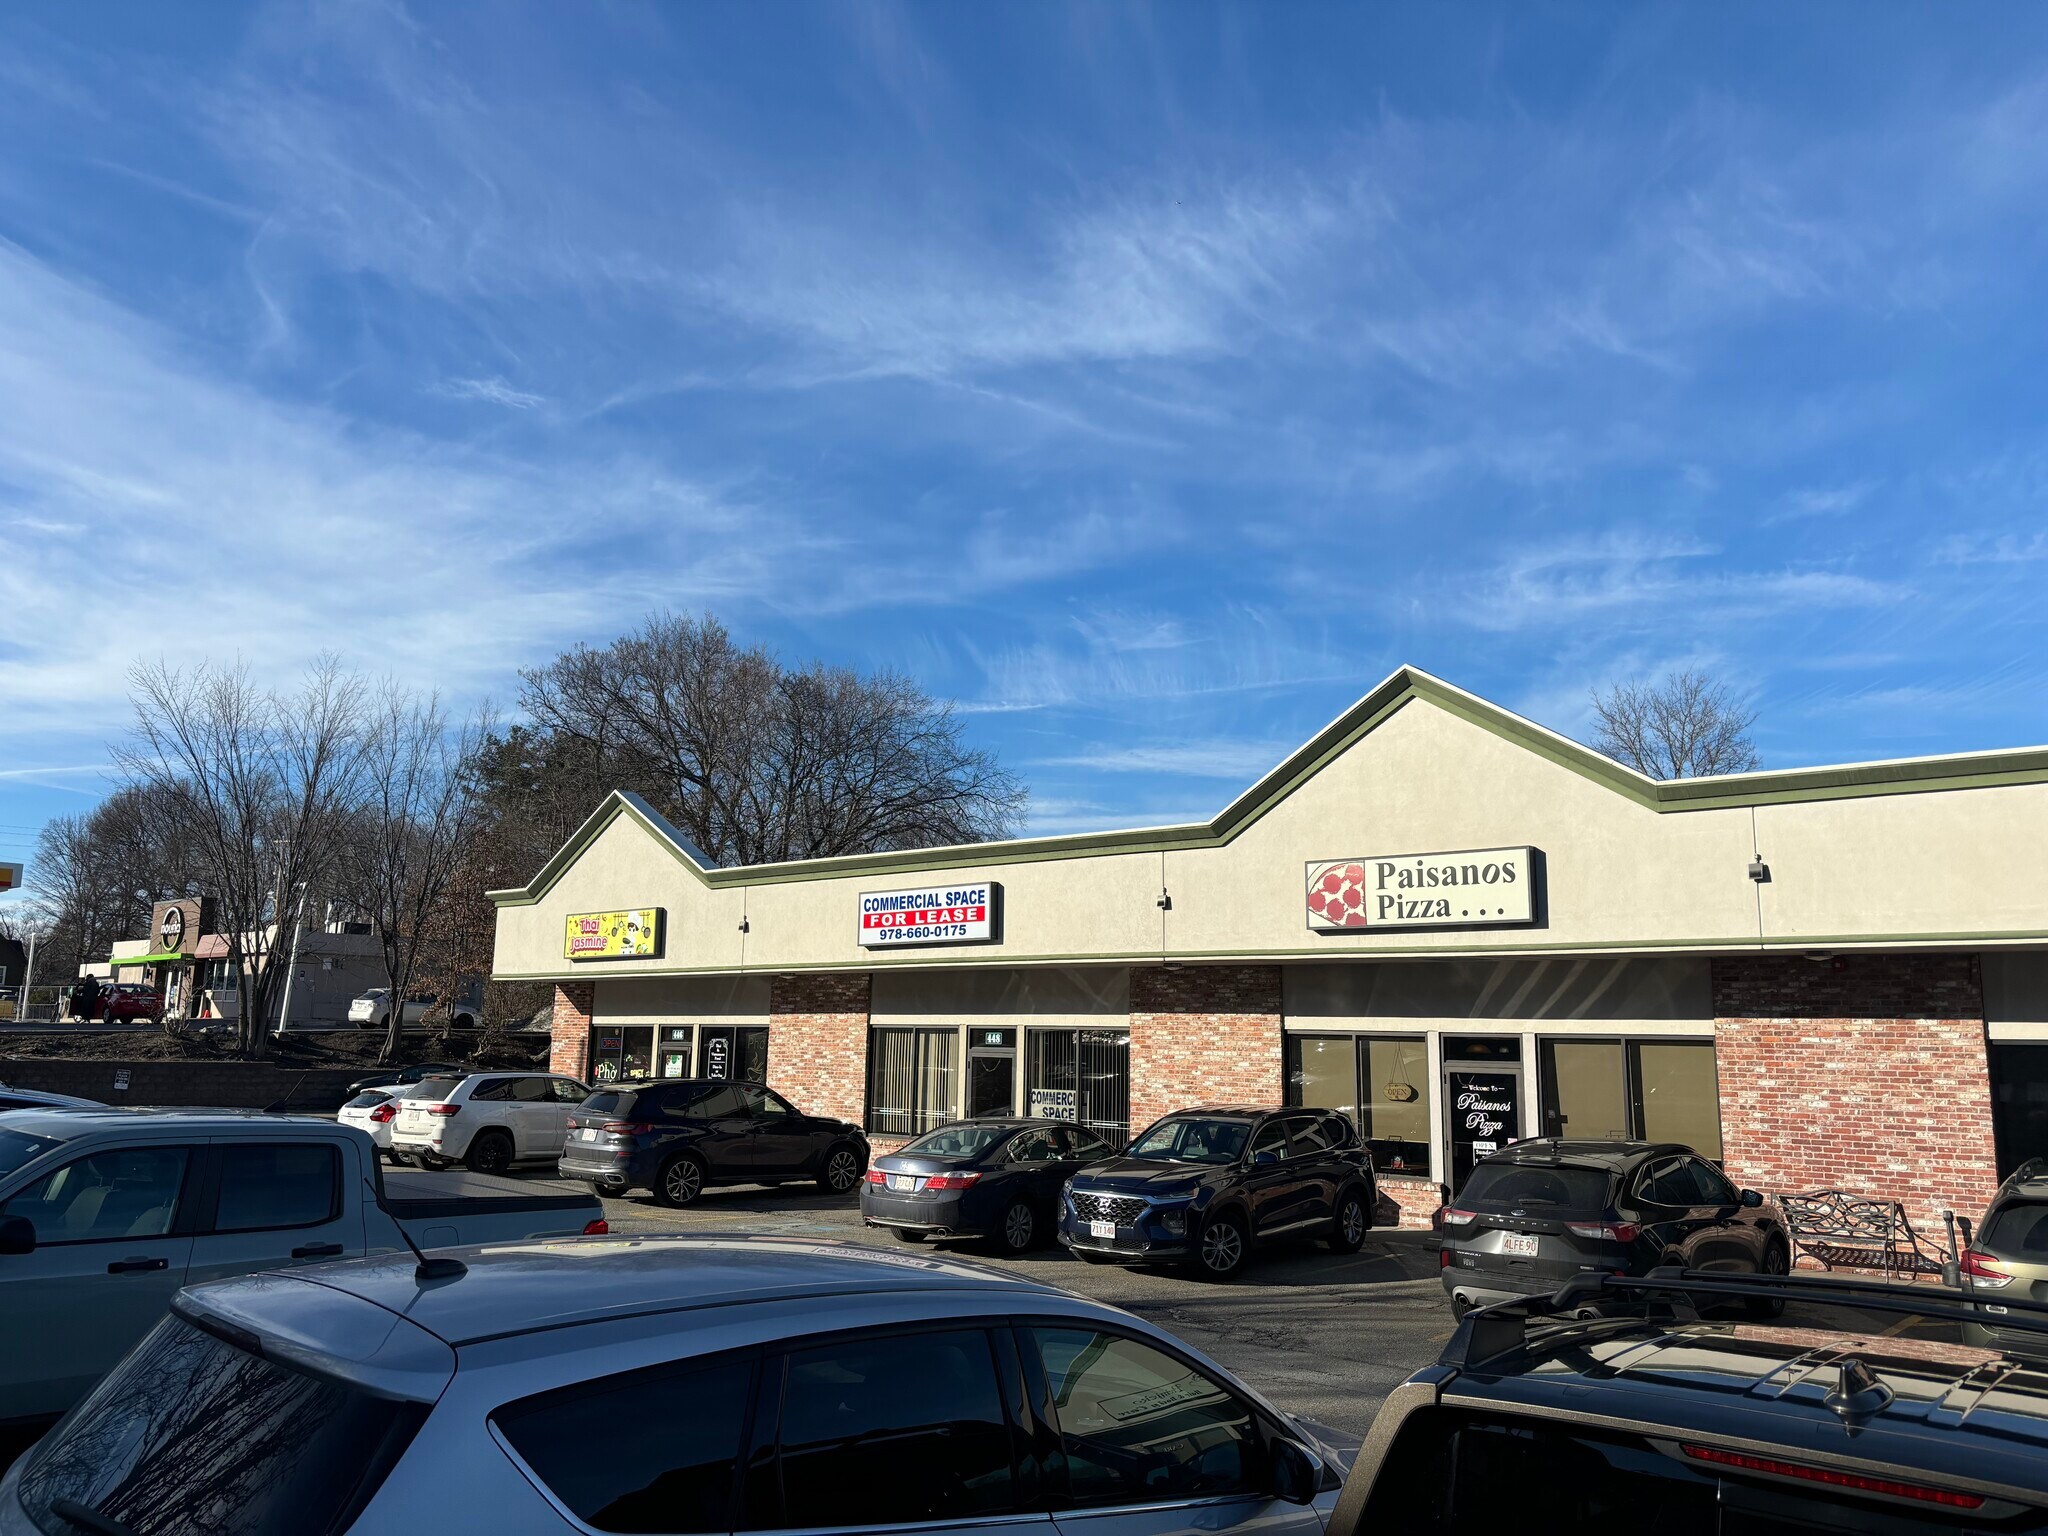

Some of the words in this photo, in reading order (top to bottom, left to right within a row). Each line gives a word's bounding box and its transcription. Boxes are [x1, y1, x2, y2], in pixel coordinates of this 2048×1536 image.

[1375, 859, 1516, 890] Paisanos
[864, 893, 942, 912] COMMERCIAL
[945, 889, 986, 907] SPACE
[1377, 893, 1452, 920] Pizza
[579, 916, 600, 933] Thai
[870, 912, 907, 927] FOR
[915, 907, 978, 924] LEASE
[880, 924, 967, 940] 978-660-0175
[602, 1039, 621, 1048] OPEN
[1387, 1088, 1407, 1096] OPEN
[1457, 1093, 1511, 1112] Paisanos
[1042, 1107, 1075, 1120] SPACE
[1466, 1112, 1503, 1137] Pizza
[1504, 1239, 1524, 1251] 4LFE
[1526, 1241, 1536, 1252] 90
